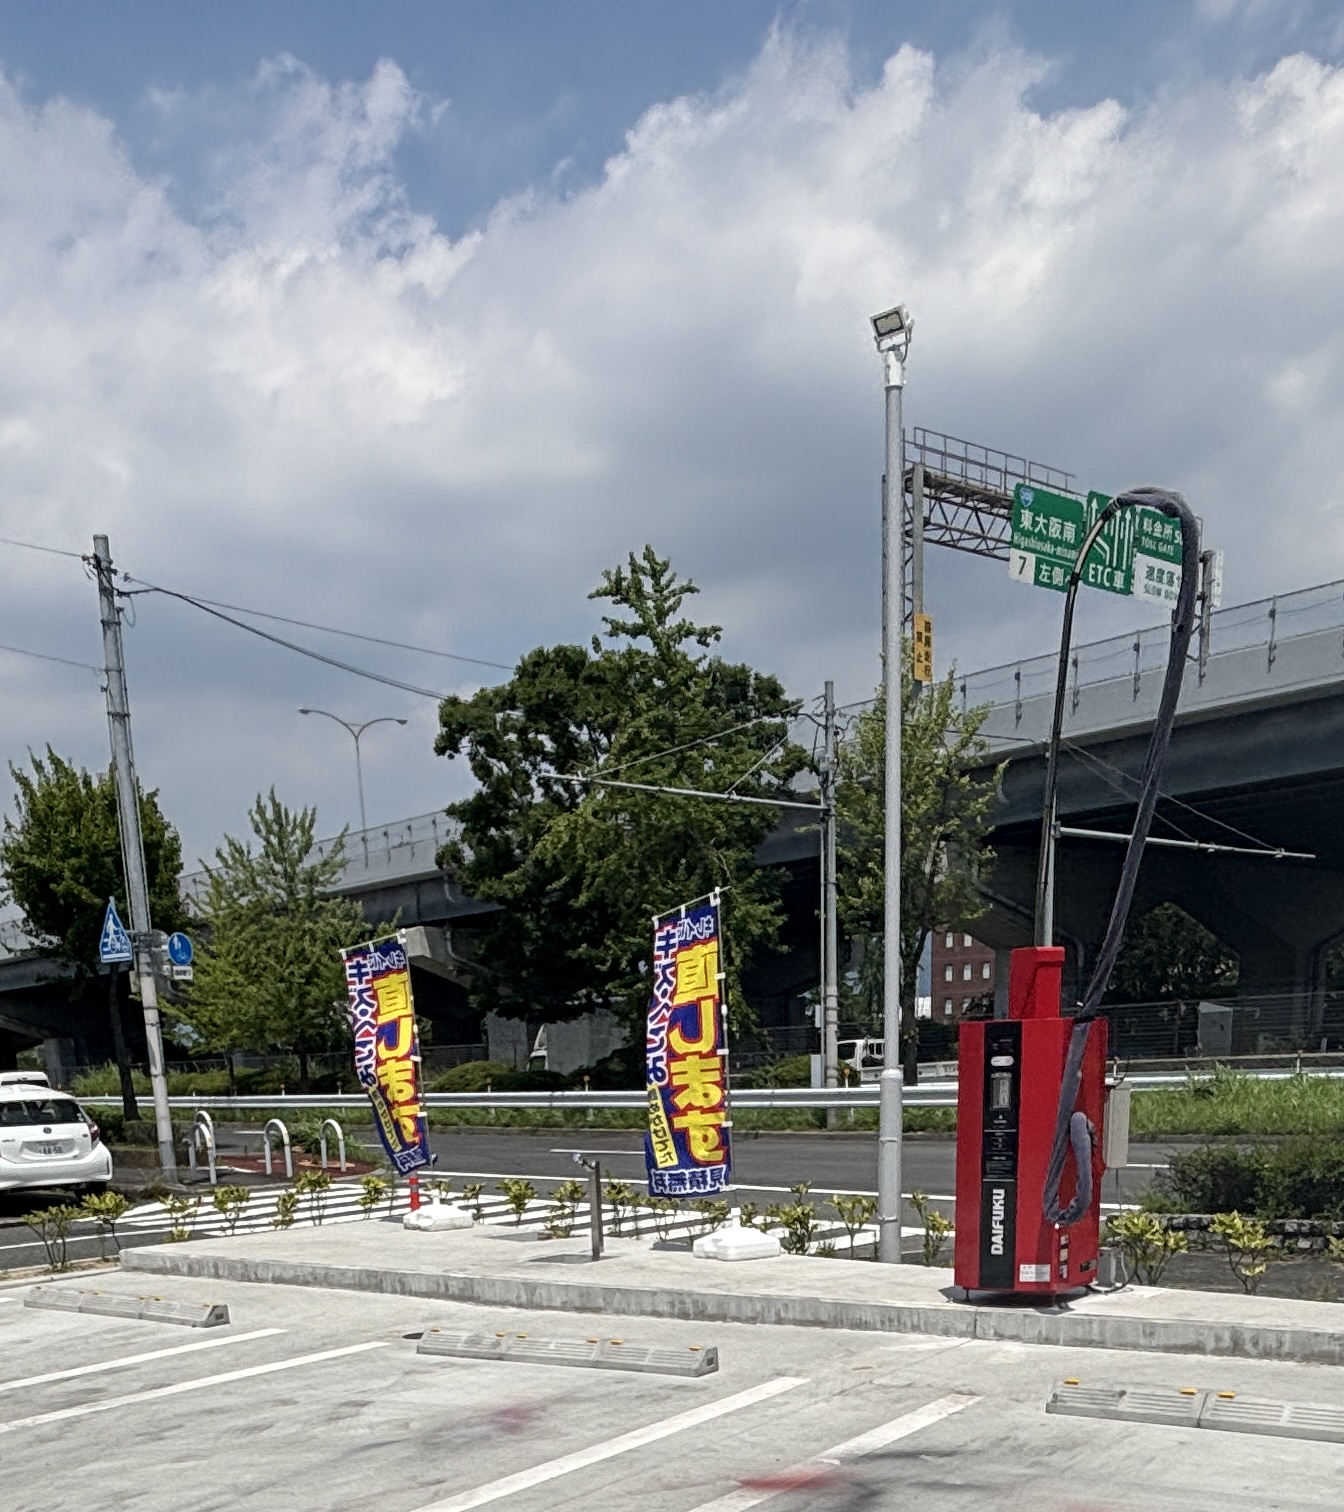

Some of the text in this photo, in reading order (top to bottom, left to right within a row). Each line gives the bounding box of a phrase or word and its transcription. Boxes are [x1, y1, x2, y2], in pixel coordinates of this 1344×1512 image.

[1019, 508, 1077, 544] 東大阪南
[1143, 517, 1173, 541] 料金所
[1158, 541, 1174, 556] GATE
[1018, 555, 1027, 576] 7
[990, 1188, 1006, 1256] DAIFUKU
